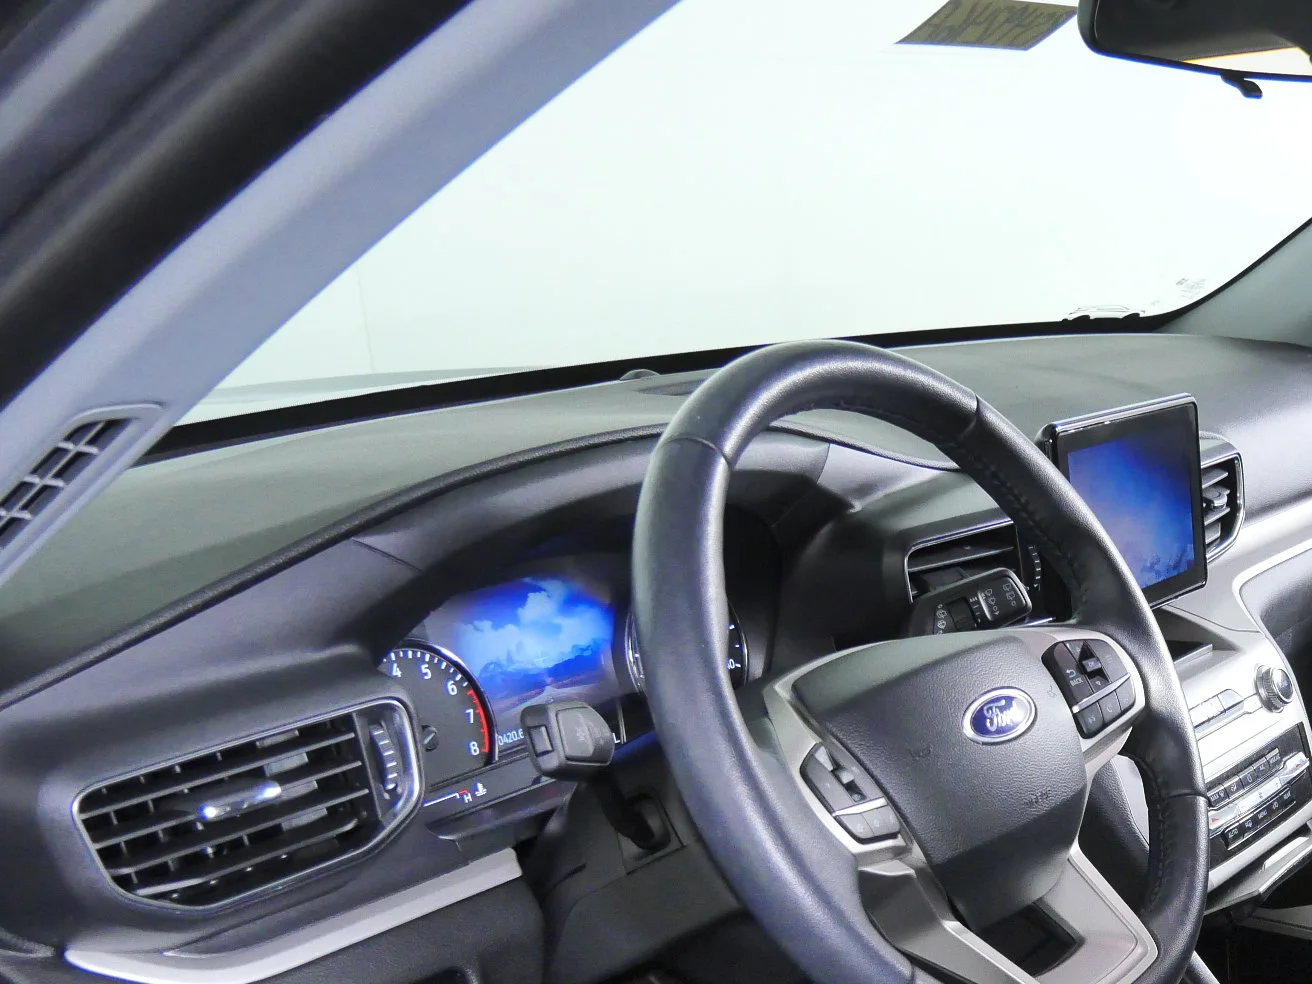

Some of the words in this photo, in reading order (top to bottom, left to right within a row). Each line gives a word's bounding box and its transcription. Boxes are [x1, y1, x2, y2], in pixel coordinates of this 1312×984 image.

[392, 664, 402, 678] 4
[421, 664, 432, 680] 5
[447, 681, 458, 696] 6
[464, 709, 474, 724] 7
[984, 699, 1018, 732] Ford
[469, 741, 480, 756] 8
[463, 792, 473, 804] H
